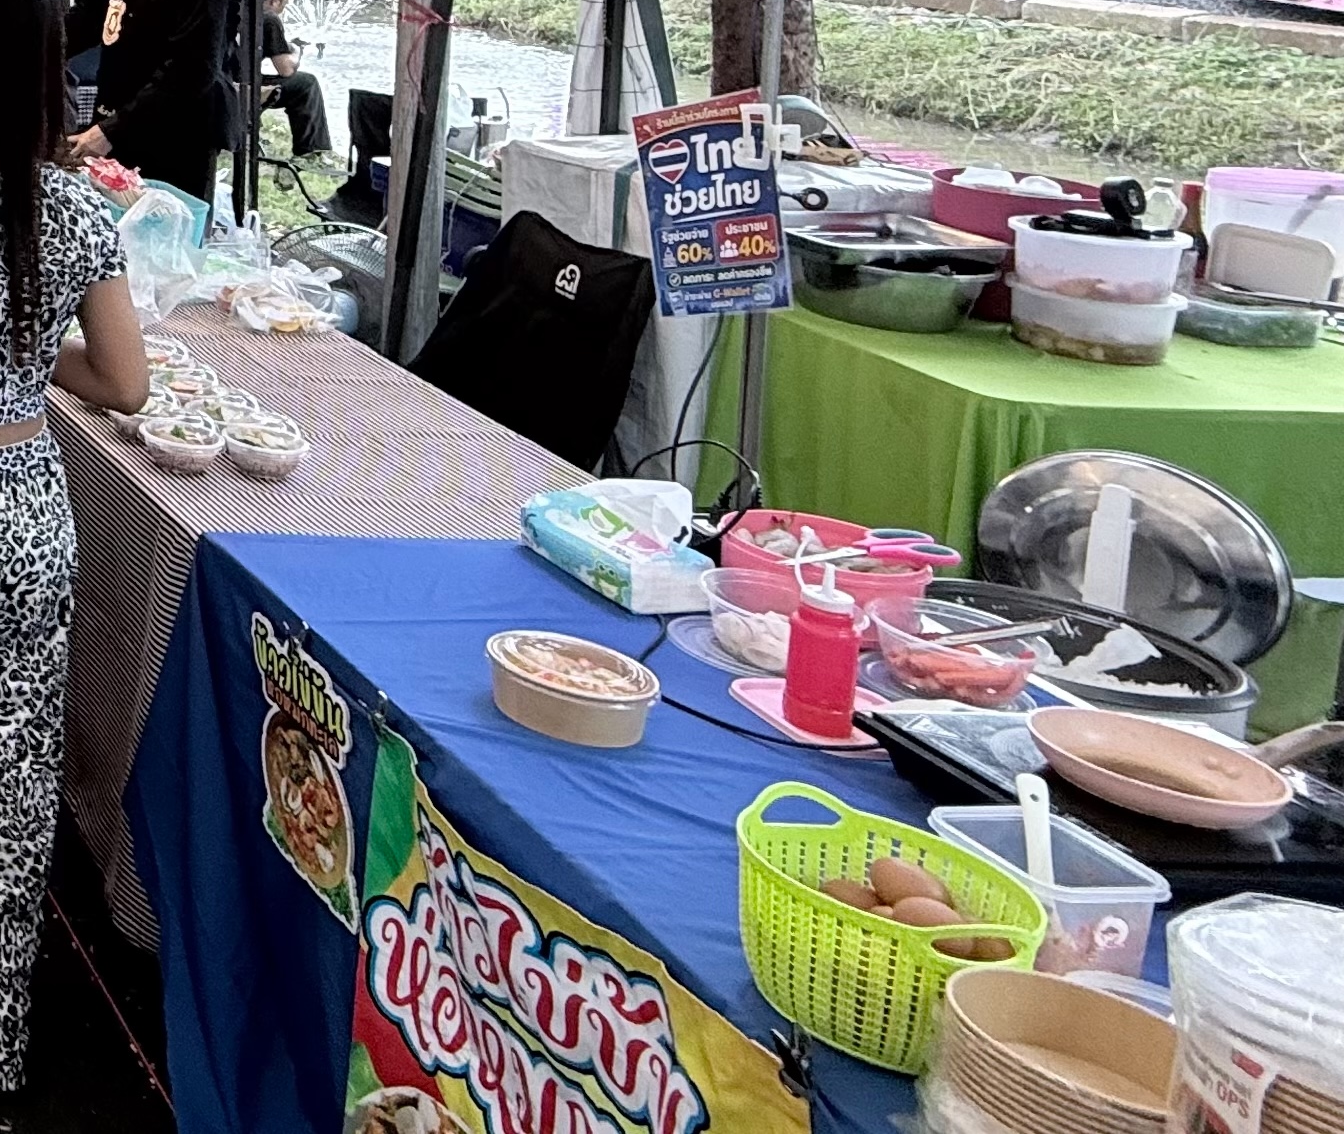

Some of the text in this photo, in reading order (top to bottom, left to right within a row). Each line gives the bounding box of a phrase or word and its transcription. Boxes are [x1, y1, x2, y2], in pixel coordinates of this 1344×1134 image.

[690, 133, 758, 174] ไทย
[663, 173, 762, 216] ช่วยไทย
[676, 243, 714, 264] 60%
[738, 235, 776, 257] 40%
